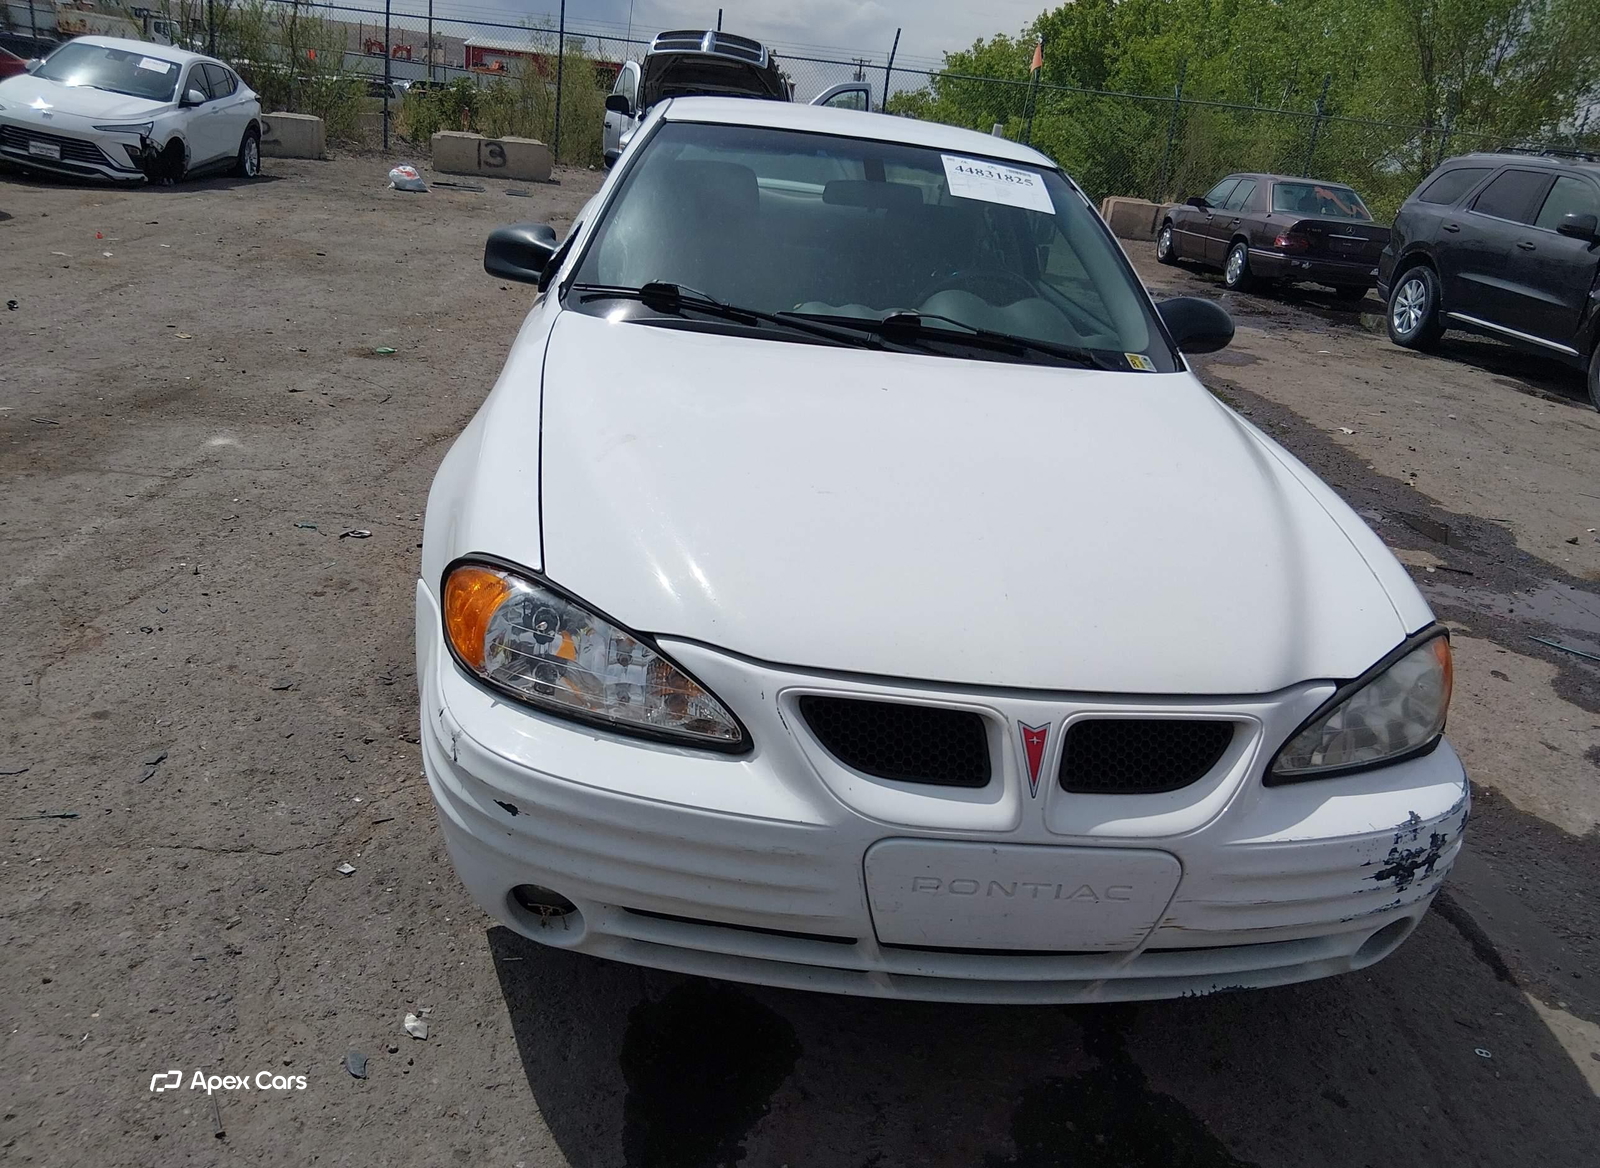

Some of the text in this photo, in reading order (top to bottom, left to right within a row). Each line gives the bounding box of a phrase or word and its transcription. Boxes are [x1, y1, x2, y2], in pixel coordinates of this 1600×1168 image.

[477, 140, 507, 169] 13
[954, 165, 1034, 187] 44831825
[911, 876, 1133, 901] PONTIAC
